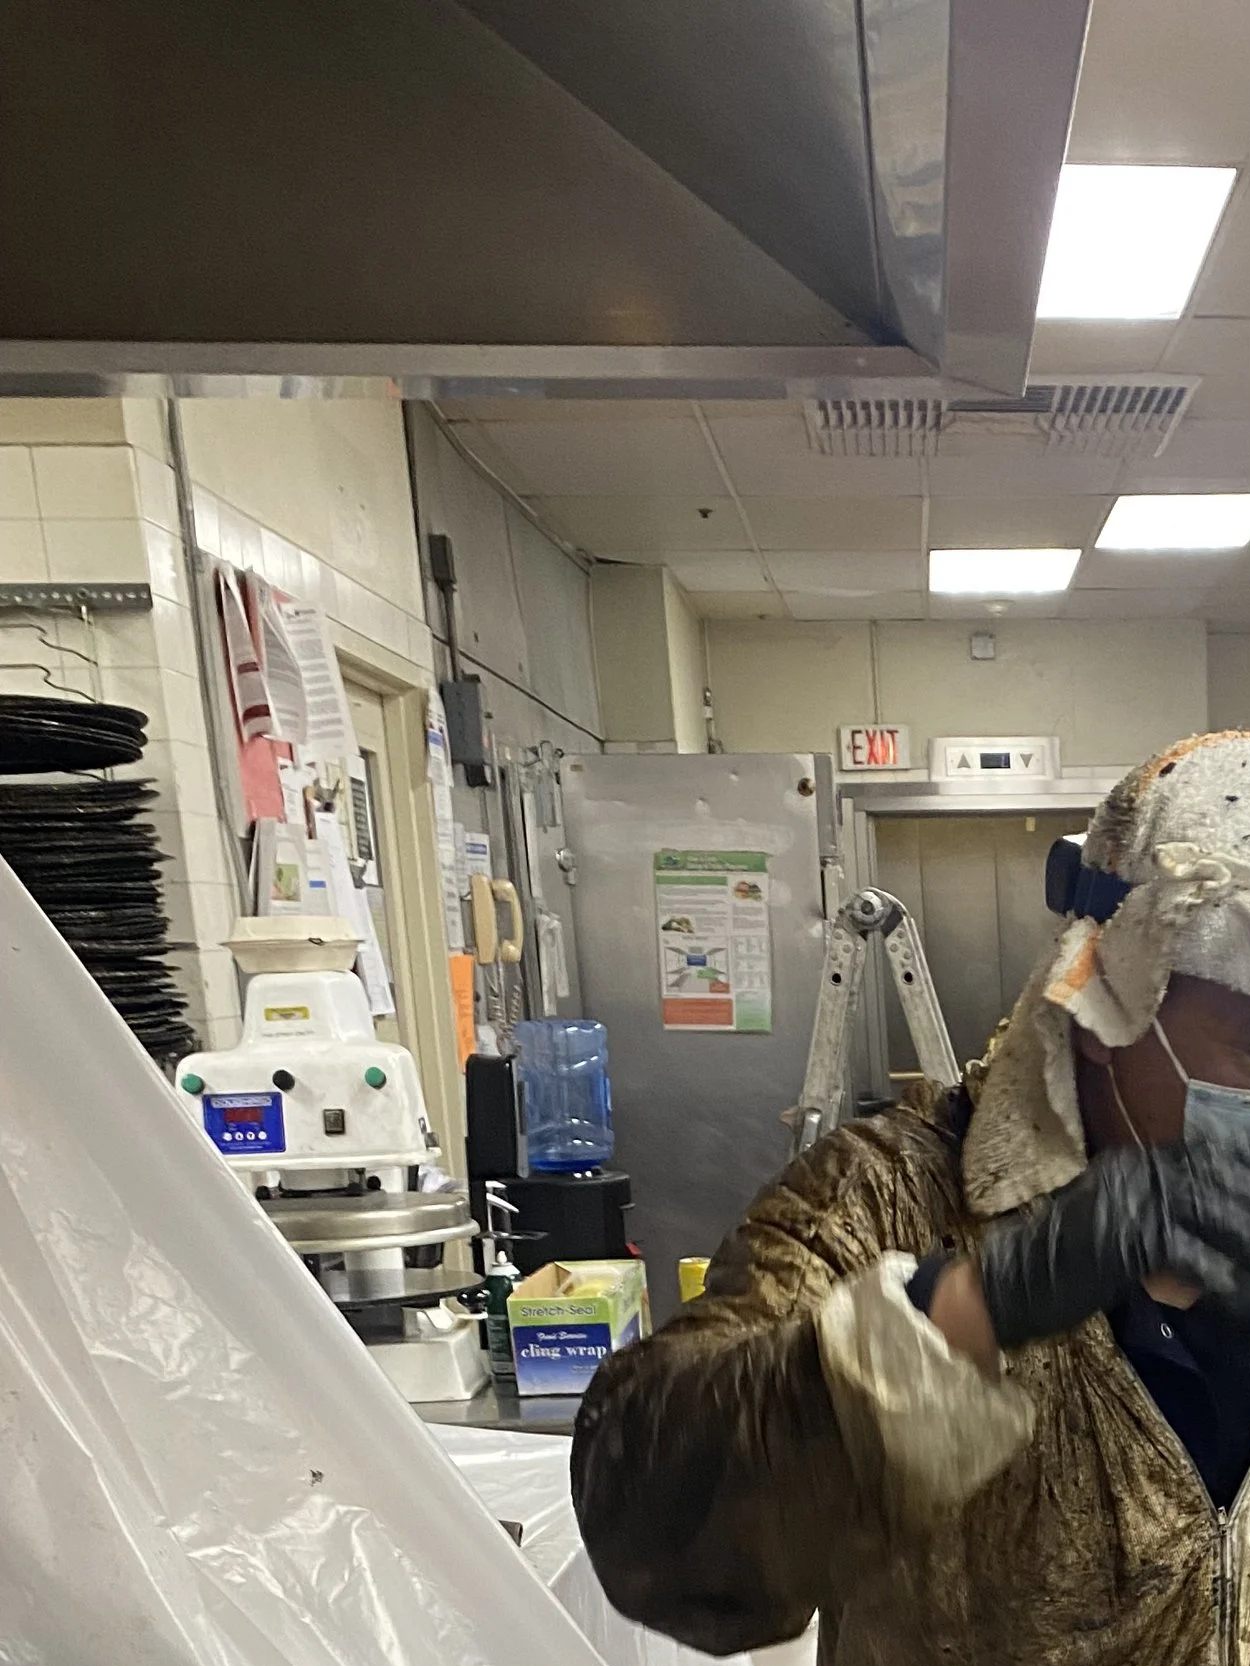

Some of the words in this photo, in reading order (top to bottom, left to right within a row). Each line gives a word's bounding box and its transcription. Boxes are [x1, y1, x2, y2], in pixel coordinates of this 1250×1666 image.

[851, 729, 899, 765] EXIT
[520, 1343, 561, 1360] cling
[566, 1345, 607, 1359] wrap
